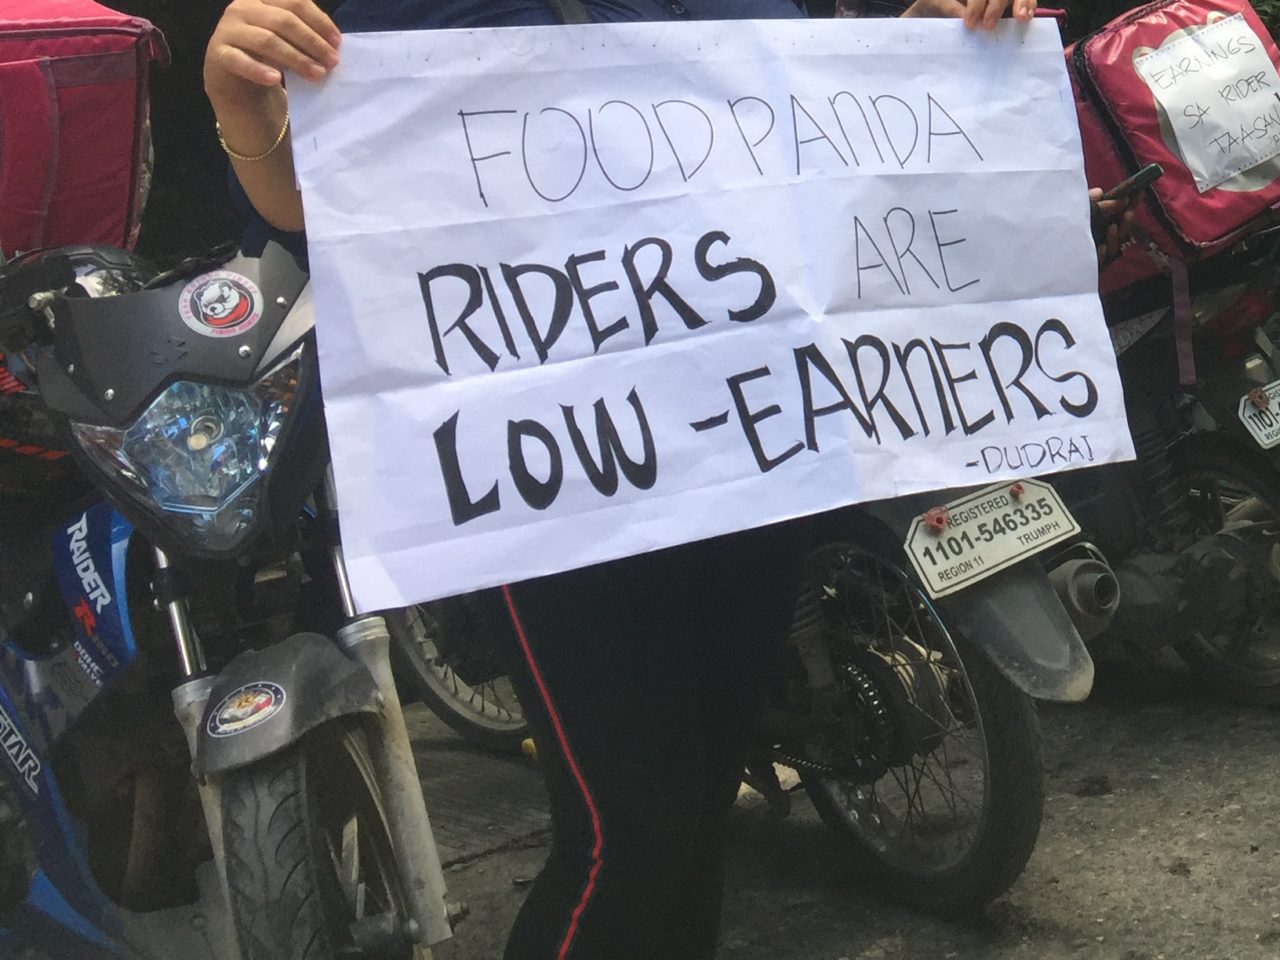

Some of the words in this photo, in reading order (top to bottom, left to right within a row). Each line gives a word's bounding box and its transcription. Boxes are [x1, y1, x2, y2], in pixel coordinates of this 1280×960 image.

[1151, 36, 1256, 90] EARNINGS
[1183, 102, 1210, 129] SA
[1218, 71, 1271, 105] RIDER
[417, 231, 777, 376] RIDERS
[853, 207, 980, 299] ARE
[923, 497, 1053, 567] 1101-546335
[947, 495, 1010, 530] REGISTERED
[67, 512, 111, 615] RAIDER
[937, 561, 974, 582] REGION
[973, 556, 985, 568] 11
[1017, 520, 1061, 546] TRUMPH
